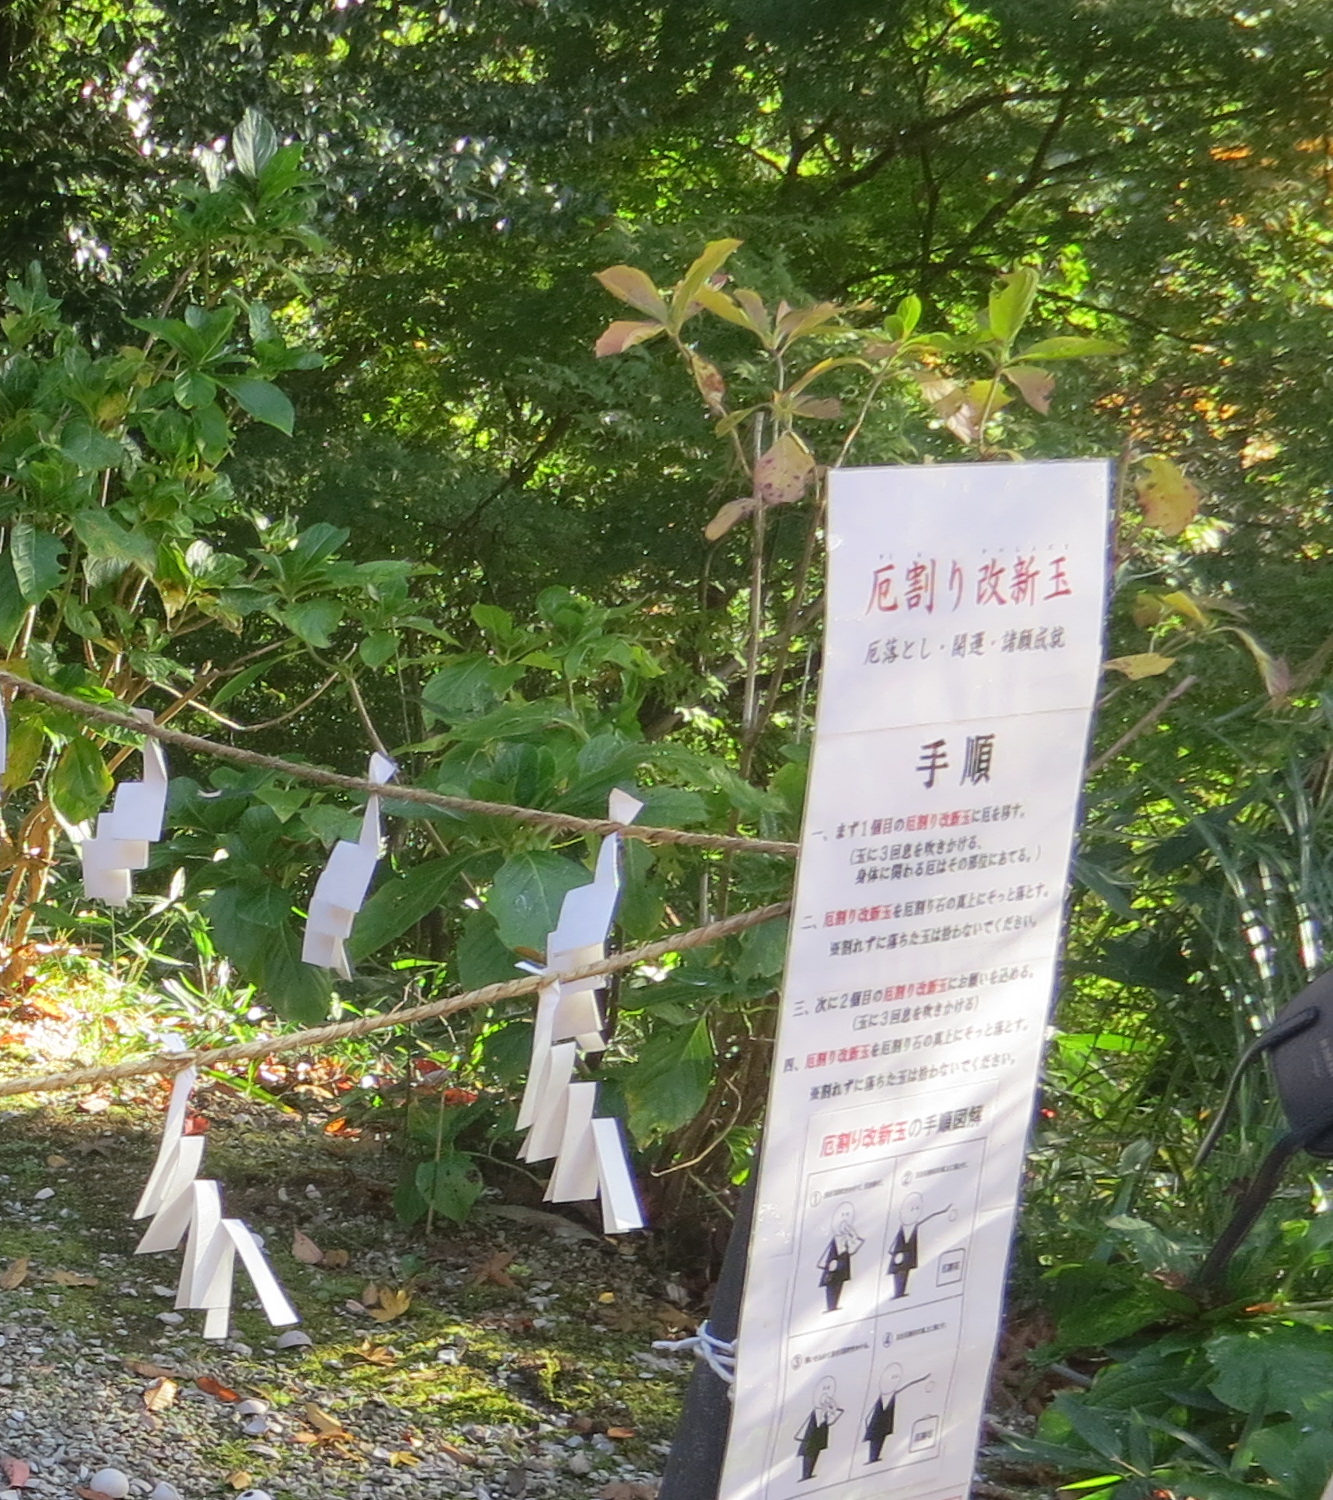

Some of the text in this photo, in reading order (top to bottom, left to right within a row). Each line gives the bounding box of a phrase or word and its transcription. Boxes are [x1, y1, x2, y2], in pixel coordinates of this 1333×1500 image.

[864, 555, 1073, 615] 厄割り改新玉
[915, 734, 995, 788] 手順
[819, 1103, 986, 1158] 厄割り改新玉の手順図解
